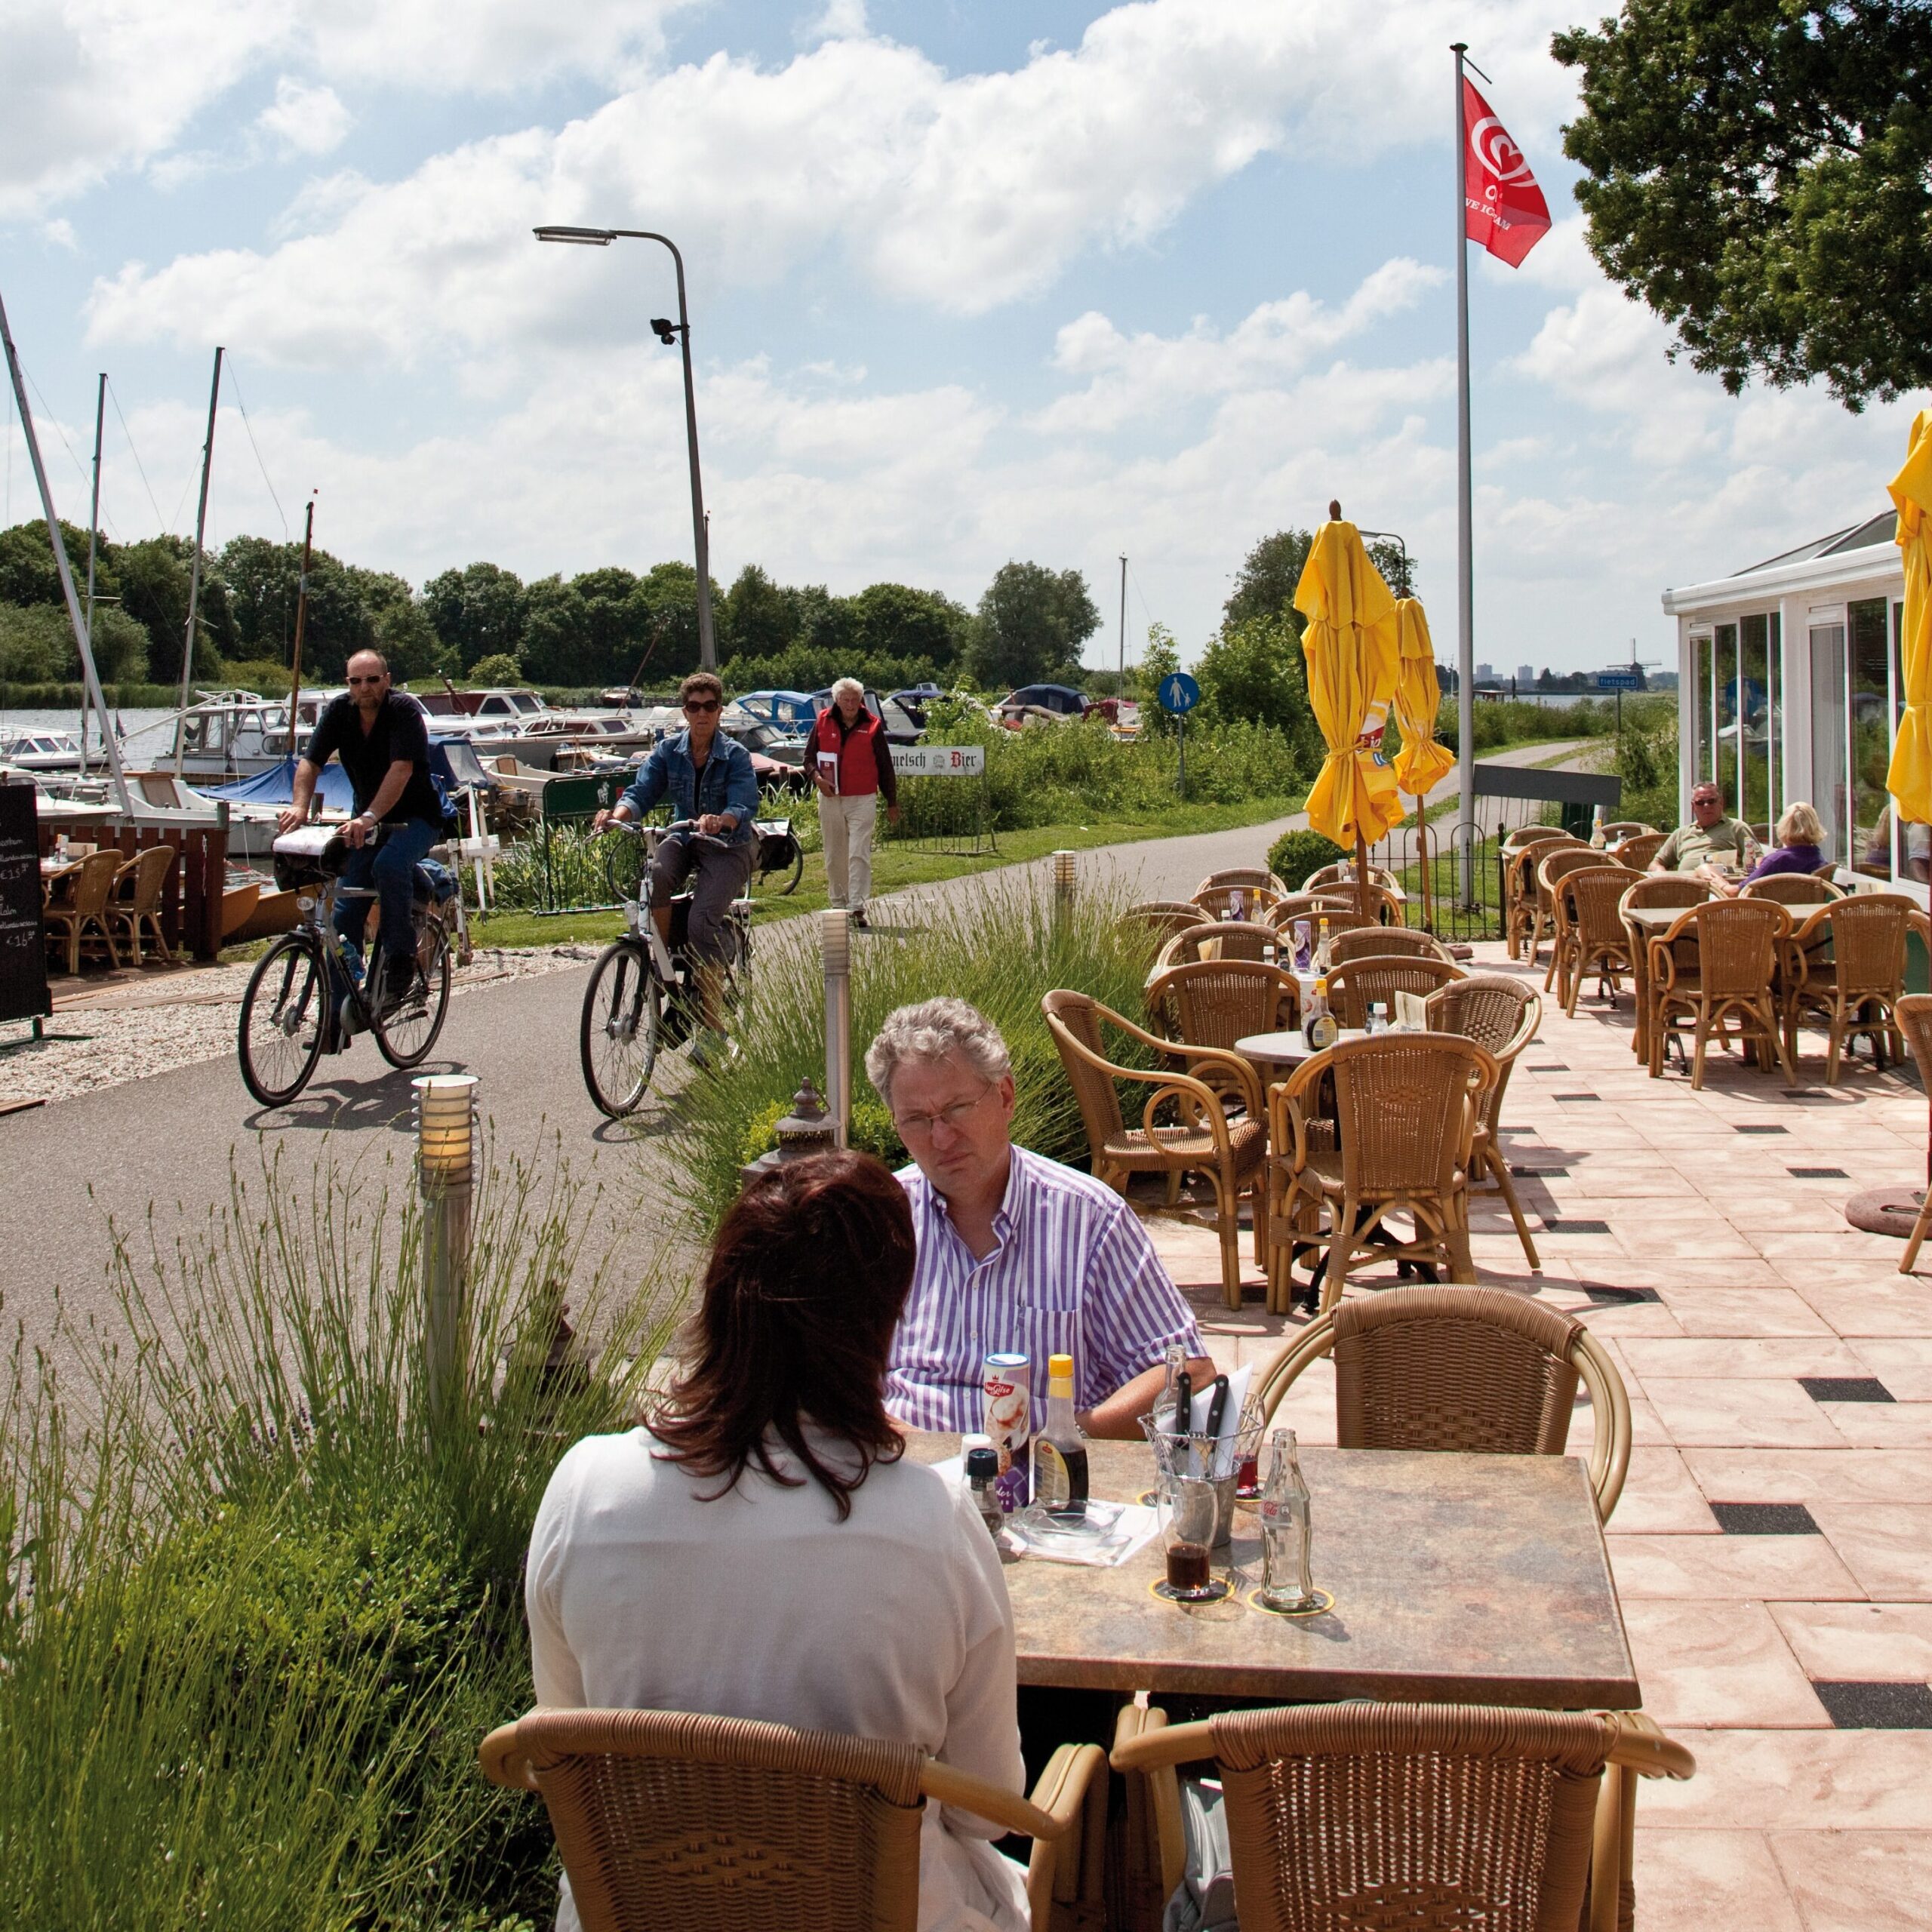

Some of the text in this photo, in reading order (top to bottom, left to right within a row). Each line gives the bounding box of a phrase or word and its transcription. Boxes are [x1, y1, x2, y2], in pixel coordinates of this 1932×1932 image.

[1600, 678, 1635, 686] fietspad
[951, 751, 977, 768] Bier
[1263, 1501, 1278, 1516] Cola
